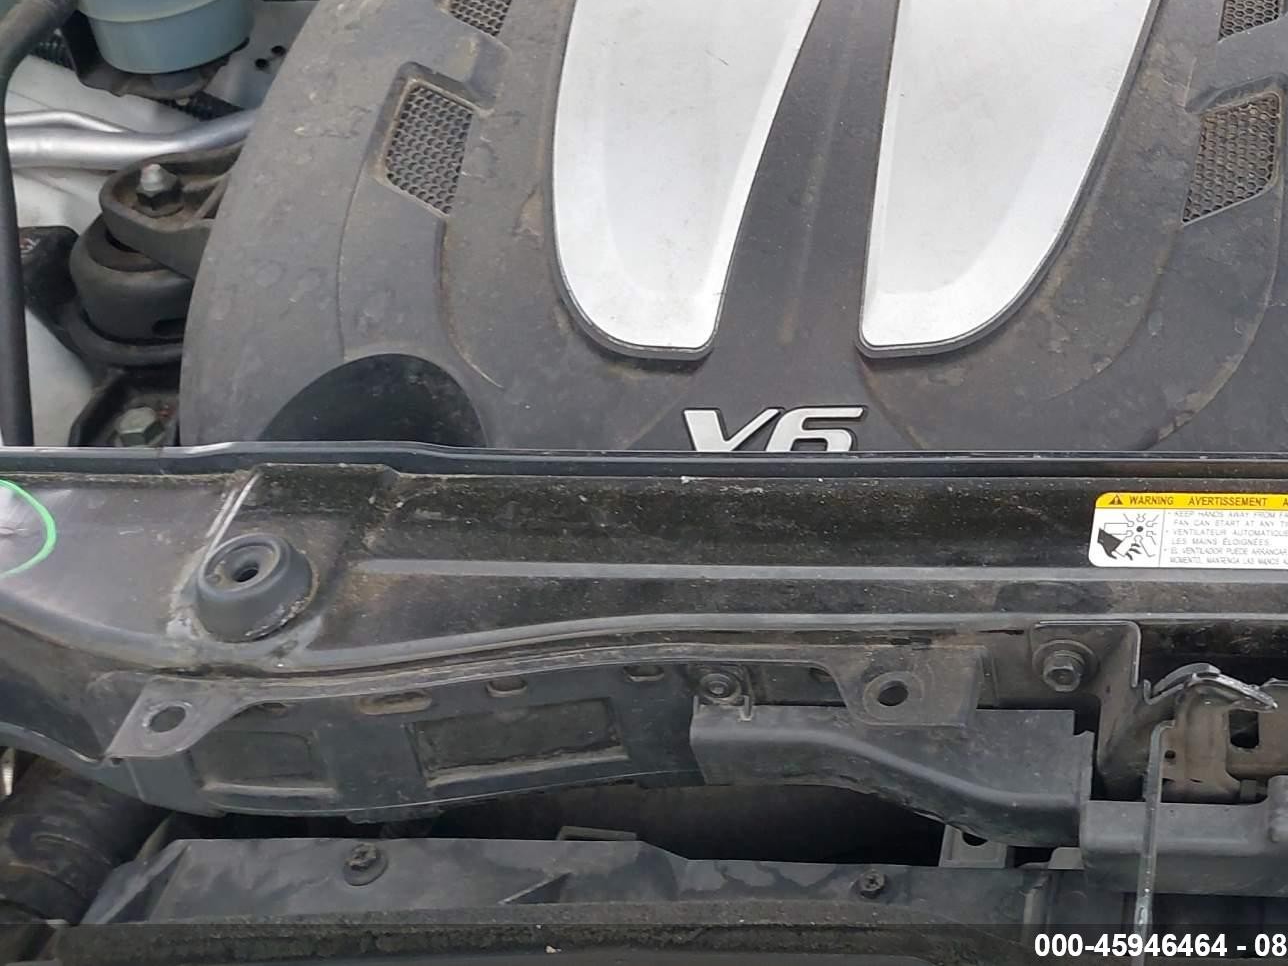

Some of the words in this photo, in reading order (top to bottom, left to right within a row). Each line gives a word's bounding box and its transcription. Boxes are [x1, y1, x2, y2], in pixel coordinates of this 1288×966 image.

[684, 407, 865, 452] V6
[1129, 495, 1174, 505] WARNING
[1188, 496, 1268, 506] AVERTISSEMENT
[1192, 538, 1218, 546] MAINS
